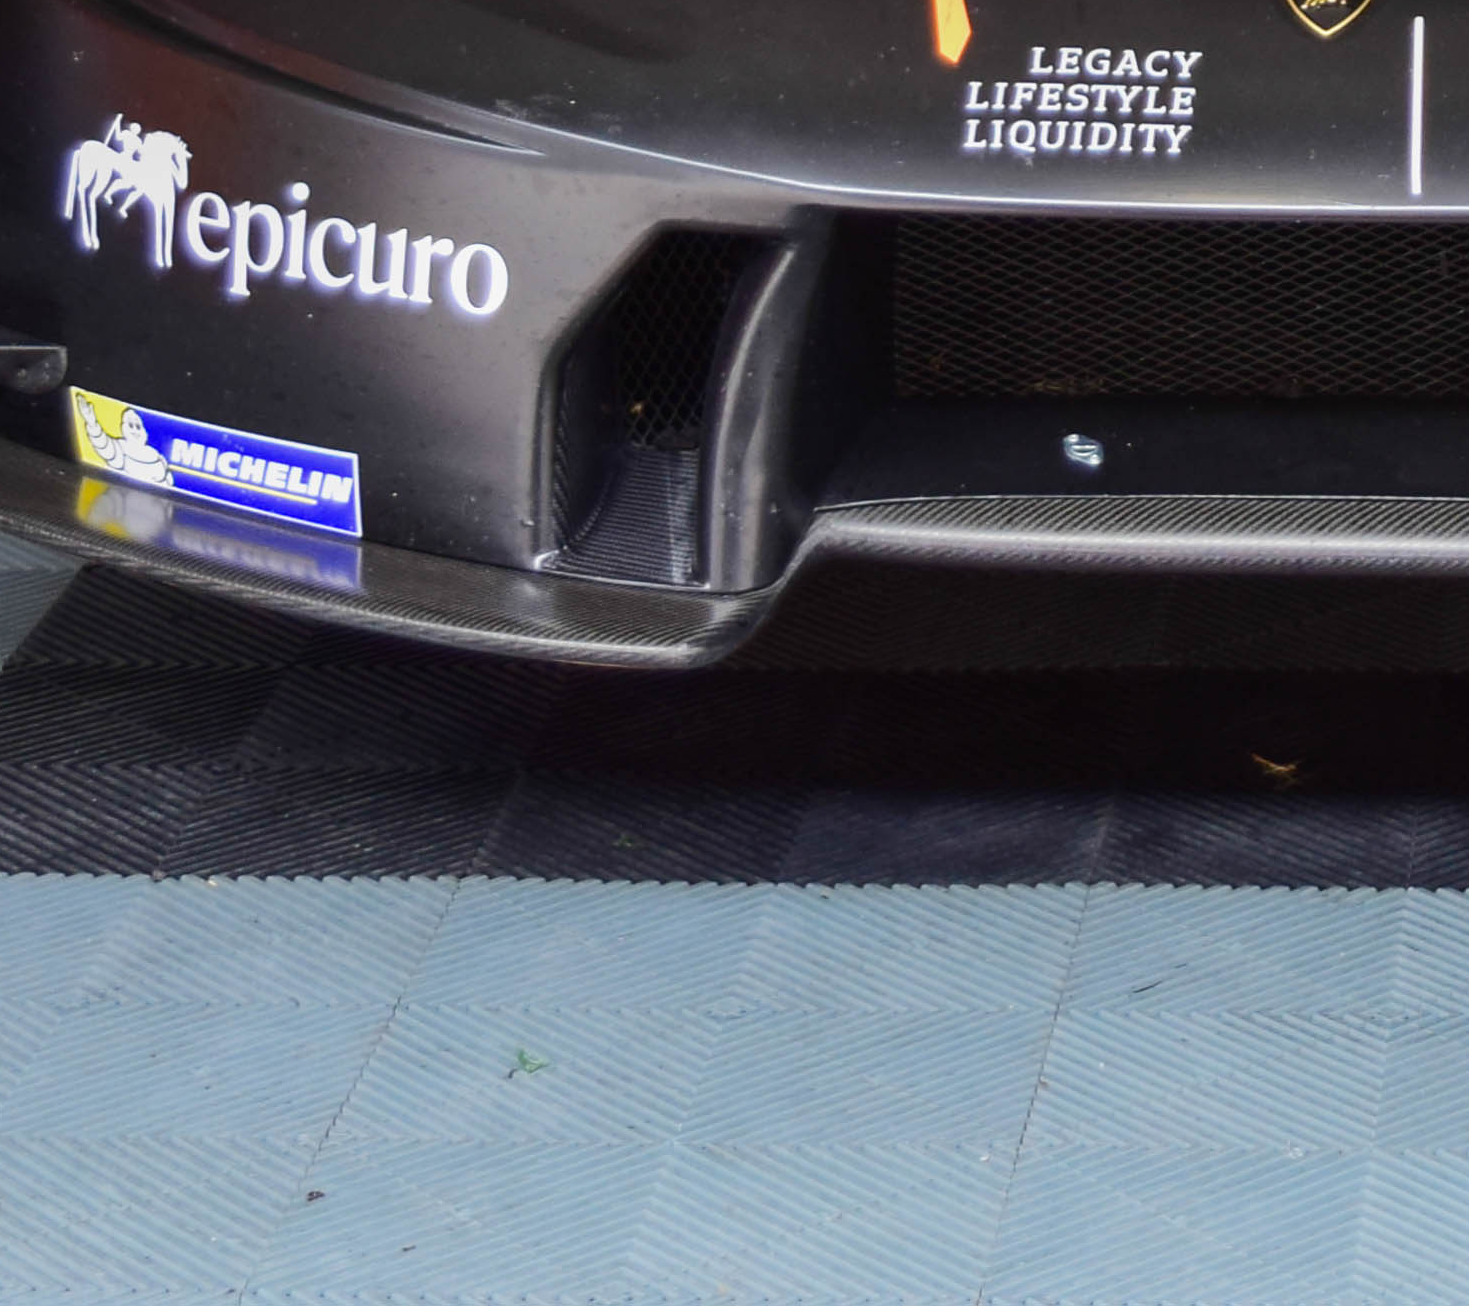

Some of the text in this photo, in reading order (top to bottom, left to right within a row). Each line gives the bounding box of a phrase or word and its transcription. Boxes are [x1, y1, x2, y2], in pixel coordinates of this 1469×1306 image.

[1030, 46, 1203, 79] LEGACY
[964, 81, 1197, 116] LIFESTYLE
[962, 118, 1193, 153] LIQUIDITY
[184, 181, 510, 317] epicuro
[168, 436, 354, 505] MICHELIN
